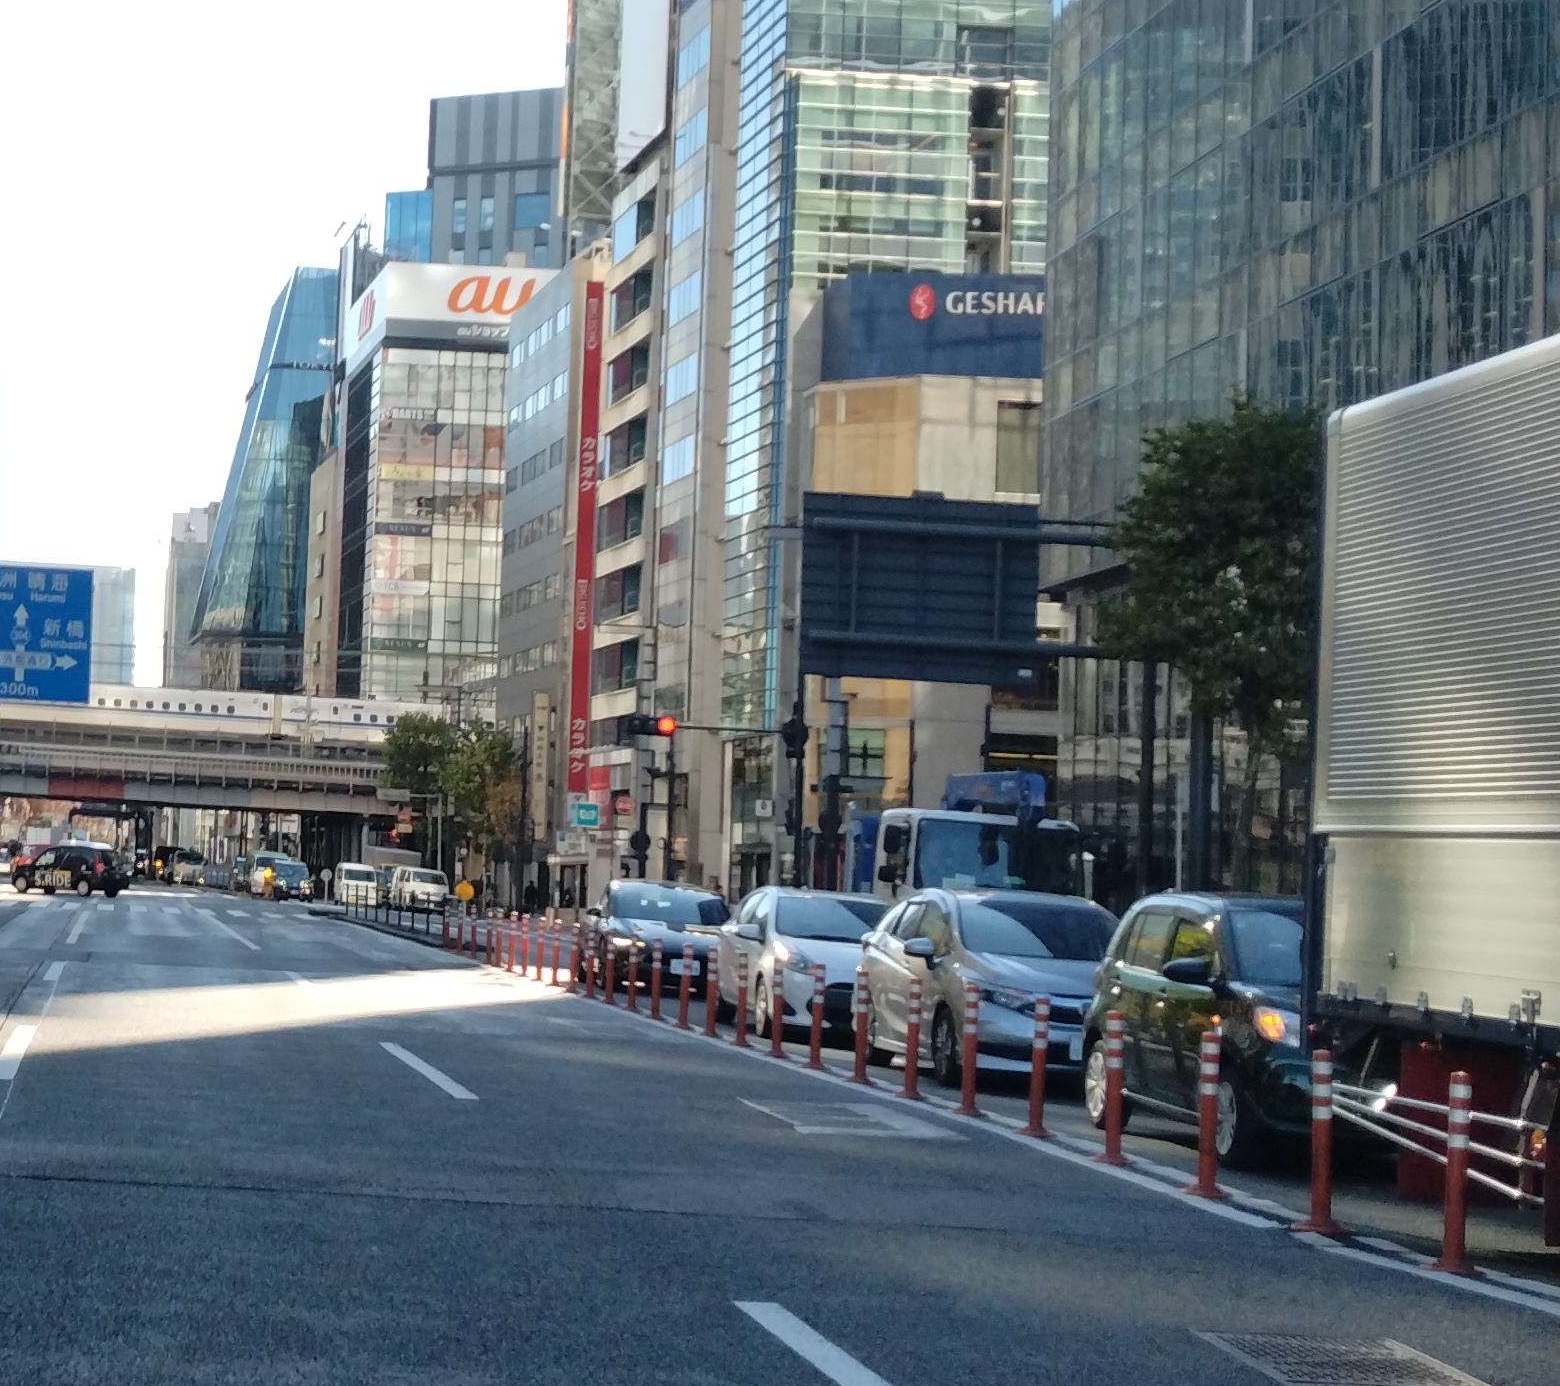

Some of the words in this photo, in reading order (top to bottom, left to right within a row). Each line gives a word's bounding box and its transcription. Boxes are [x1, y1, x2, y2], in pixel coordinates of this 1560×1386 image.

[447, 275, 537, 315] au
[580, 436, 597, 492] カラオケ
[27, 571, 69, 593] 晴海
[30, 592, 66, 604] Harumi
[44, 618, 85, 639] 新橋
[40, 638, 88, 651] Shinbashi
[0, 682, 40, 696] 300m
[569, 717, 587, 774] カラオケ
[34, 874, 72, 888] S.RIDE
